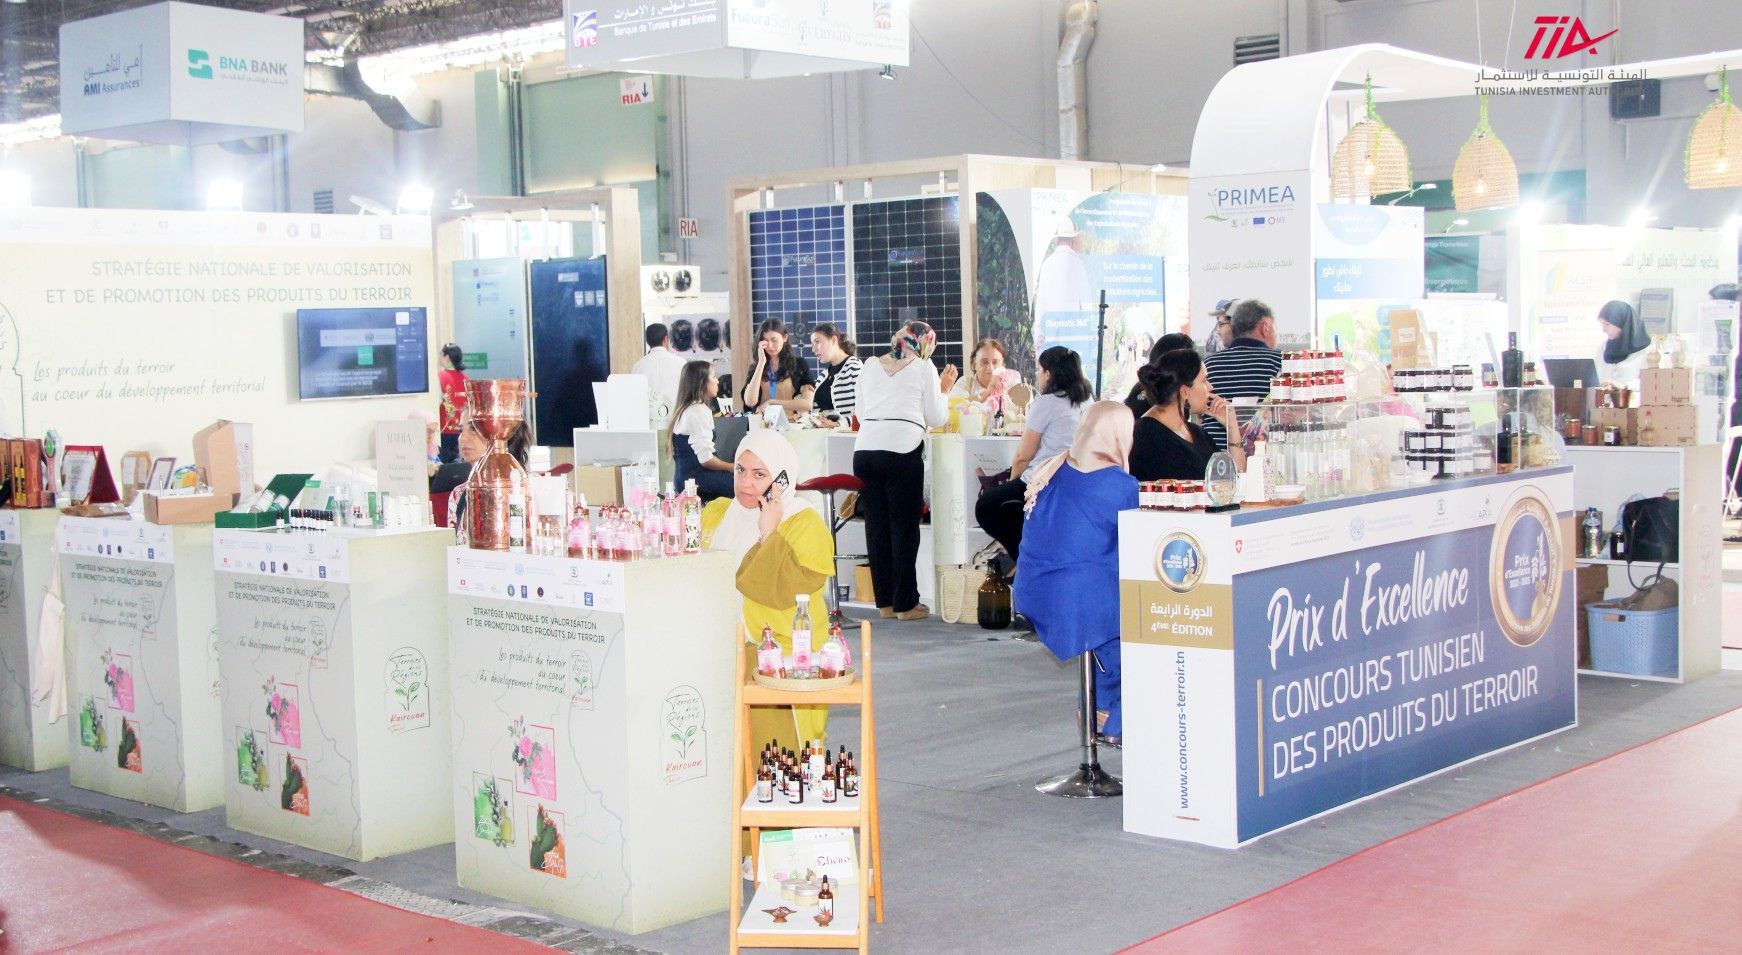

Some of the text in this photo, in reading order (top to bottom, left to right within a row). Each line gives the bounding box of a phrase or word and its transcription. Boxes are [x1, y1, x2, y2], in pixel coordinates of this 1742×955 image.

[614, 26, 638, 36] Banque
[639, 24, 647, 33] de
[648, 20, 670, 31] Tunisie
[671, 19, 678, 28] et
[679, 16, 691, 27] des
[731, 8, 790, 31] FuturaSun
[220, 56, 288, 76] BNA BANK
[84, 80, 141, 97] AMI Assurances
[622, 93, 642, 105] RIA
[1218, 185, 1296, 206] PRIMEA
[680, 220, 698, 237] RIA
[92, 258, 412, 276] STRATÉGIE NATIONALE DE VALORISATION
[47, 287, 412, 304] ET DE PROMOTION DES PRODUITS DU TERROIR
[1045, 320, 1075, 330] Diagnostic
[33, 359, 175, 381] Les produits du terroir
[32, 380, 266, 402] au coeur du développement territorial
[1514, 553, 1530, 567] Prix
[473, 607, 597, 630] STRATÉGIE NATIONALE DE VALORISATION
[1150, 603, 1213, 618] الدورة الرابعة
[466, 618, 606, 644] ET DE PROMOTION DES PRODUITS DU TERROIR
[1172, 621, 1213, 636] ÉDITION
[1267, 587, 1323, 670] Prix
[509, 650, 533, 665] produits
[535, 652, 543, 666] du
[546, 654, 567, 668] terroir
[548, 671, 567, 681] coeur
[1271, 630, 1485, 723] CONCOURS TUNISIEN
[535, 681, 566, 695] territorial
[390, 712, 425, 723] Kairouan
[1272, 664, 1539, 780] DES PRODUITS DU TERROIR
[1175, 650, 1189, 810] www.concours-terroir.tn
[665, 760, 703, 774] Kairouan
